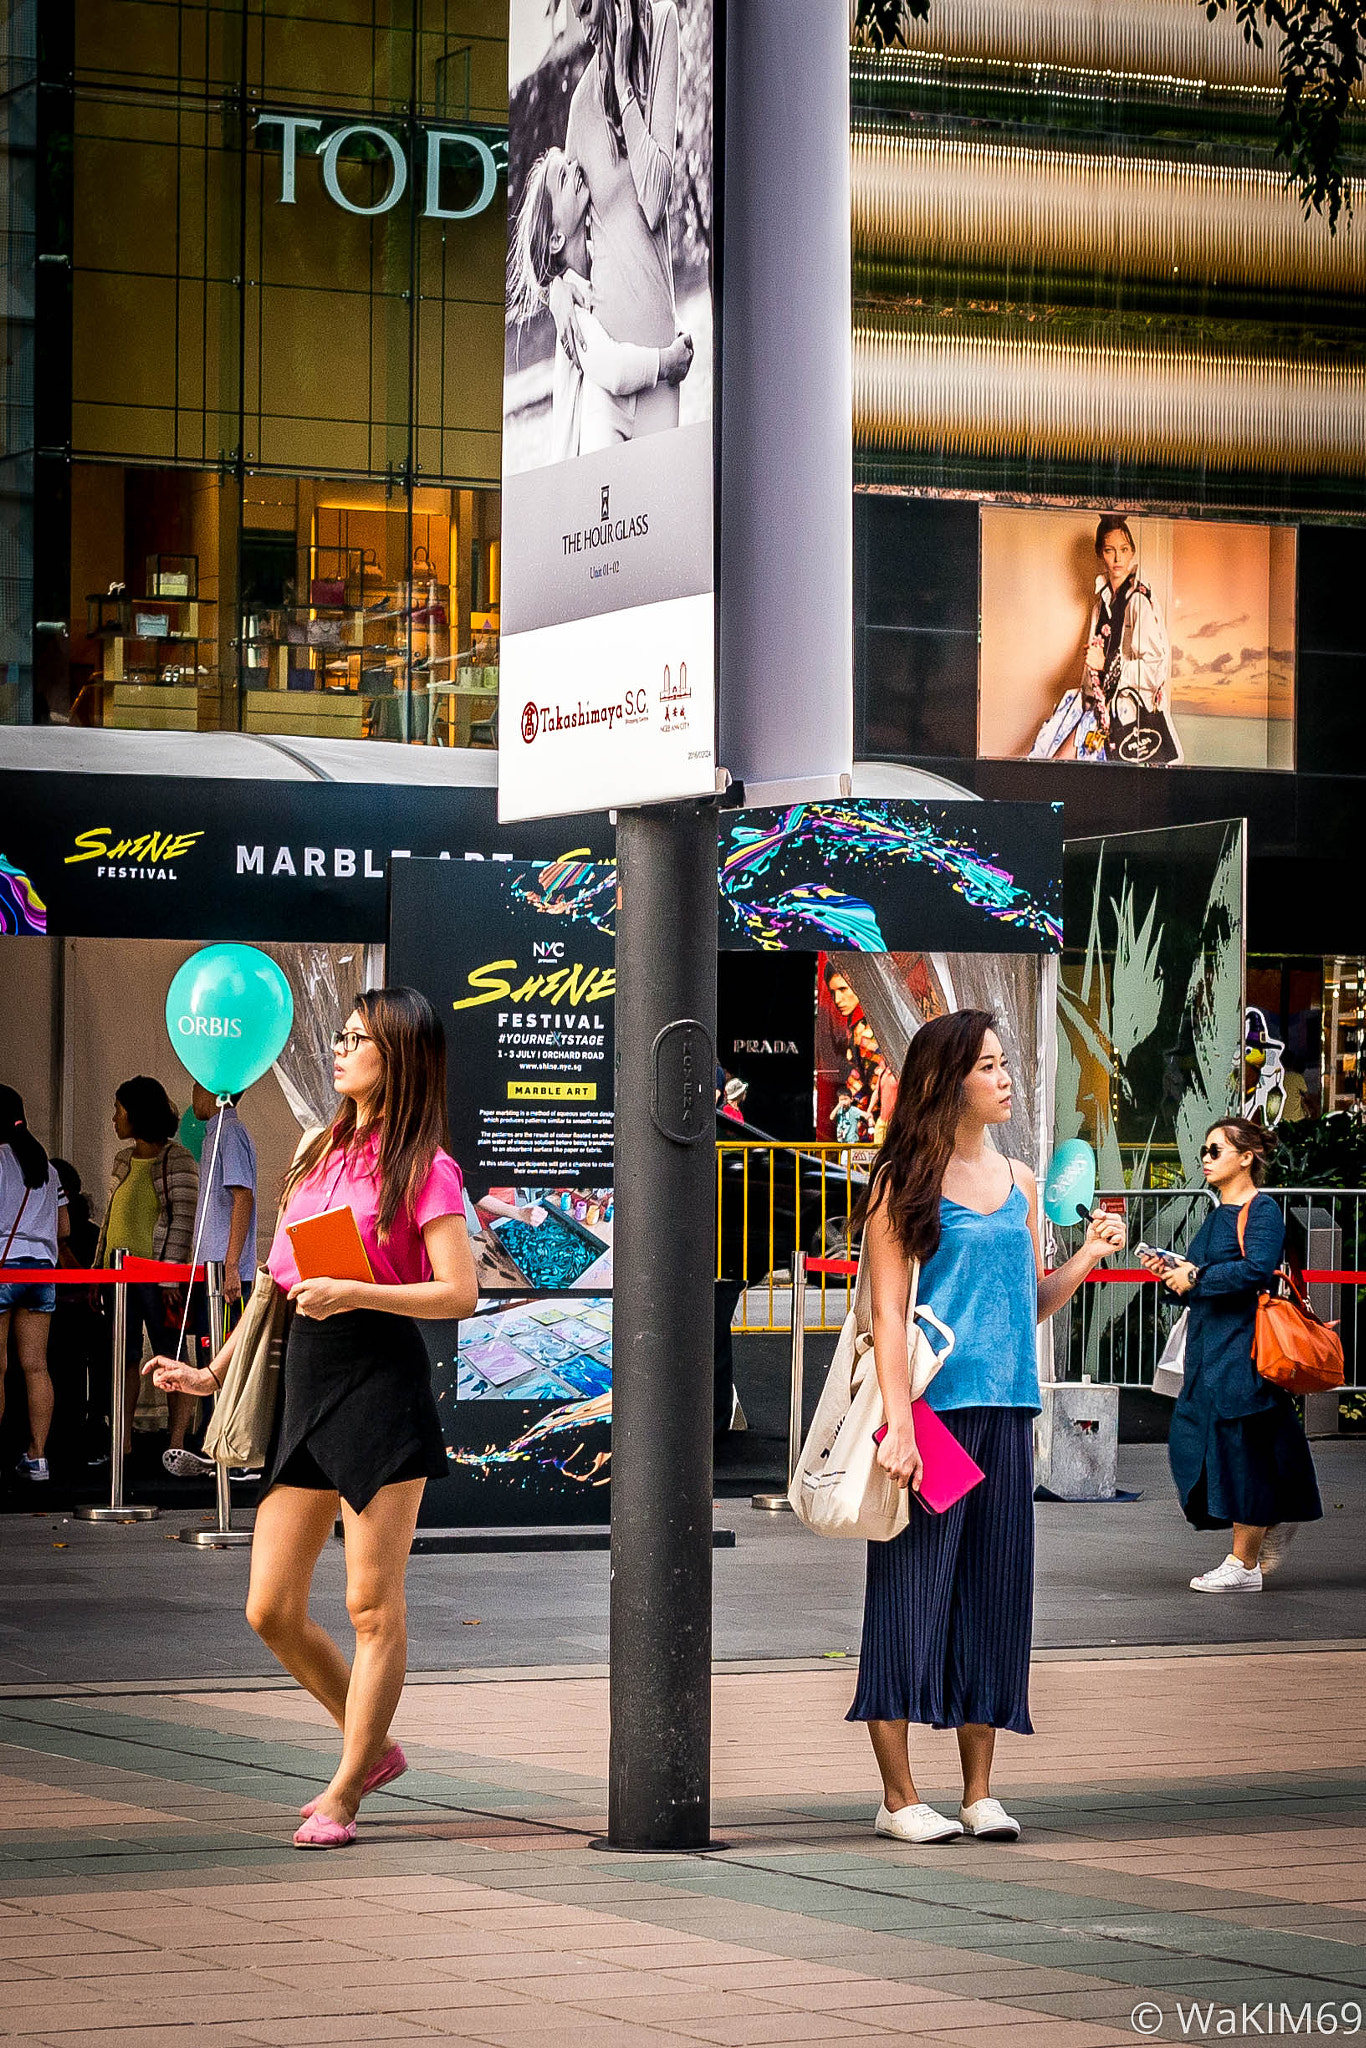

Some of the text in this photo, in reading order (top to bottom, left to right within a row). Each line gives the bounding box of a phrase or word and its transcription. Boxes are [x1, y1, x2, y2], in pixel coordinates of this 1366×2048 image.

[562, 514, 649, 555] THE HOUR GLASS
[589, 566, 603, 579] Unit
[540, 688, 649, 733] Takashimaya S.C.
[64, 828, 205, 864] SHINE
[236, 846, 411, 878] MARBL
[97, 866, 178, 881] FESTIVAL
[533, 941, 565, 957] NYC
[177, 1015, 242, 1038] ORBIS
[498, 1013, 605, 1030] FESTIVAL
[498, 1031, 605, 1047] #YOURNEXTSTAGE
[733, 1040, 799, 1054] PRADA
[516, 1050, 537, 1059] JULY
[542, 1051, 581, 1060] ORCHARD
[582, 1051, 605, 1060] ROAD
[519, 1063, 582, 1072] www.shine.nyc.sg
[515, 1086, 589, 1096] MARBLE ART
